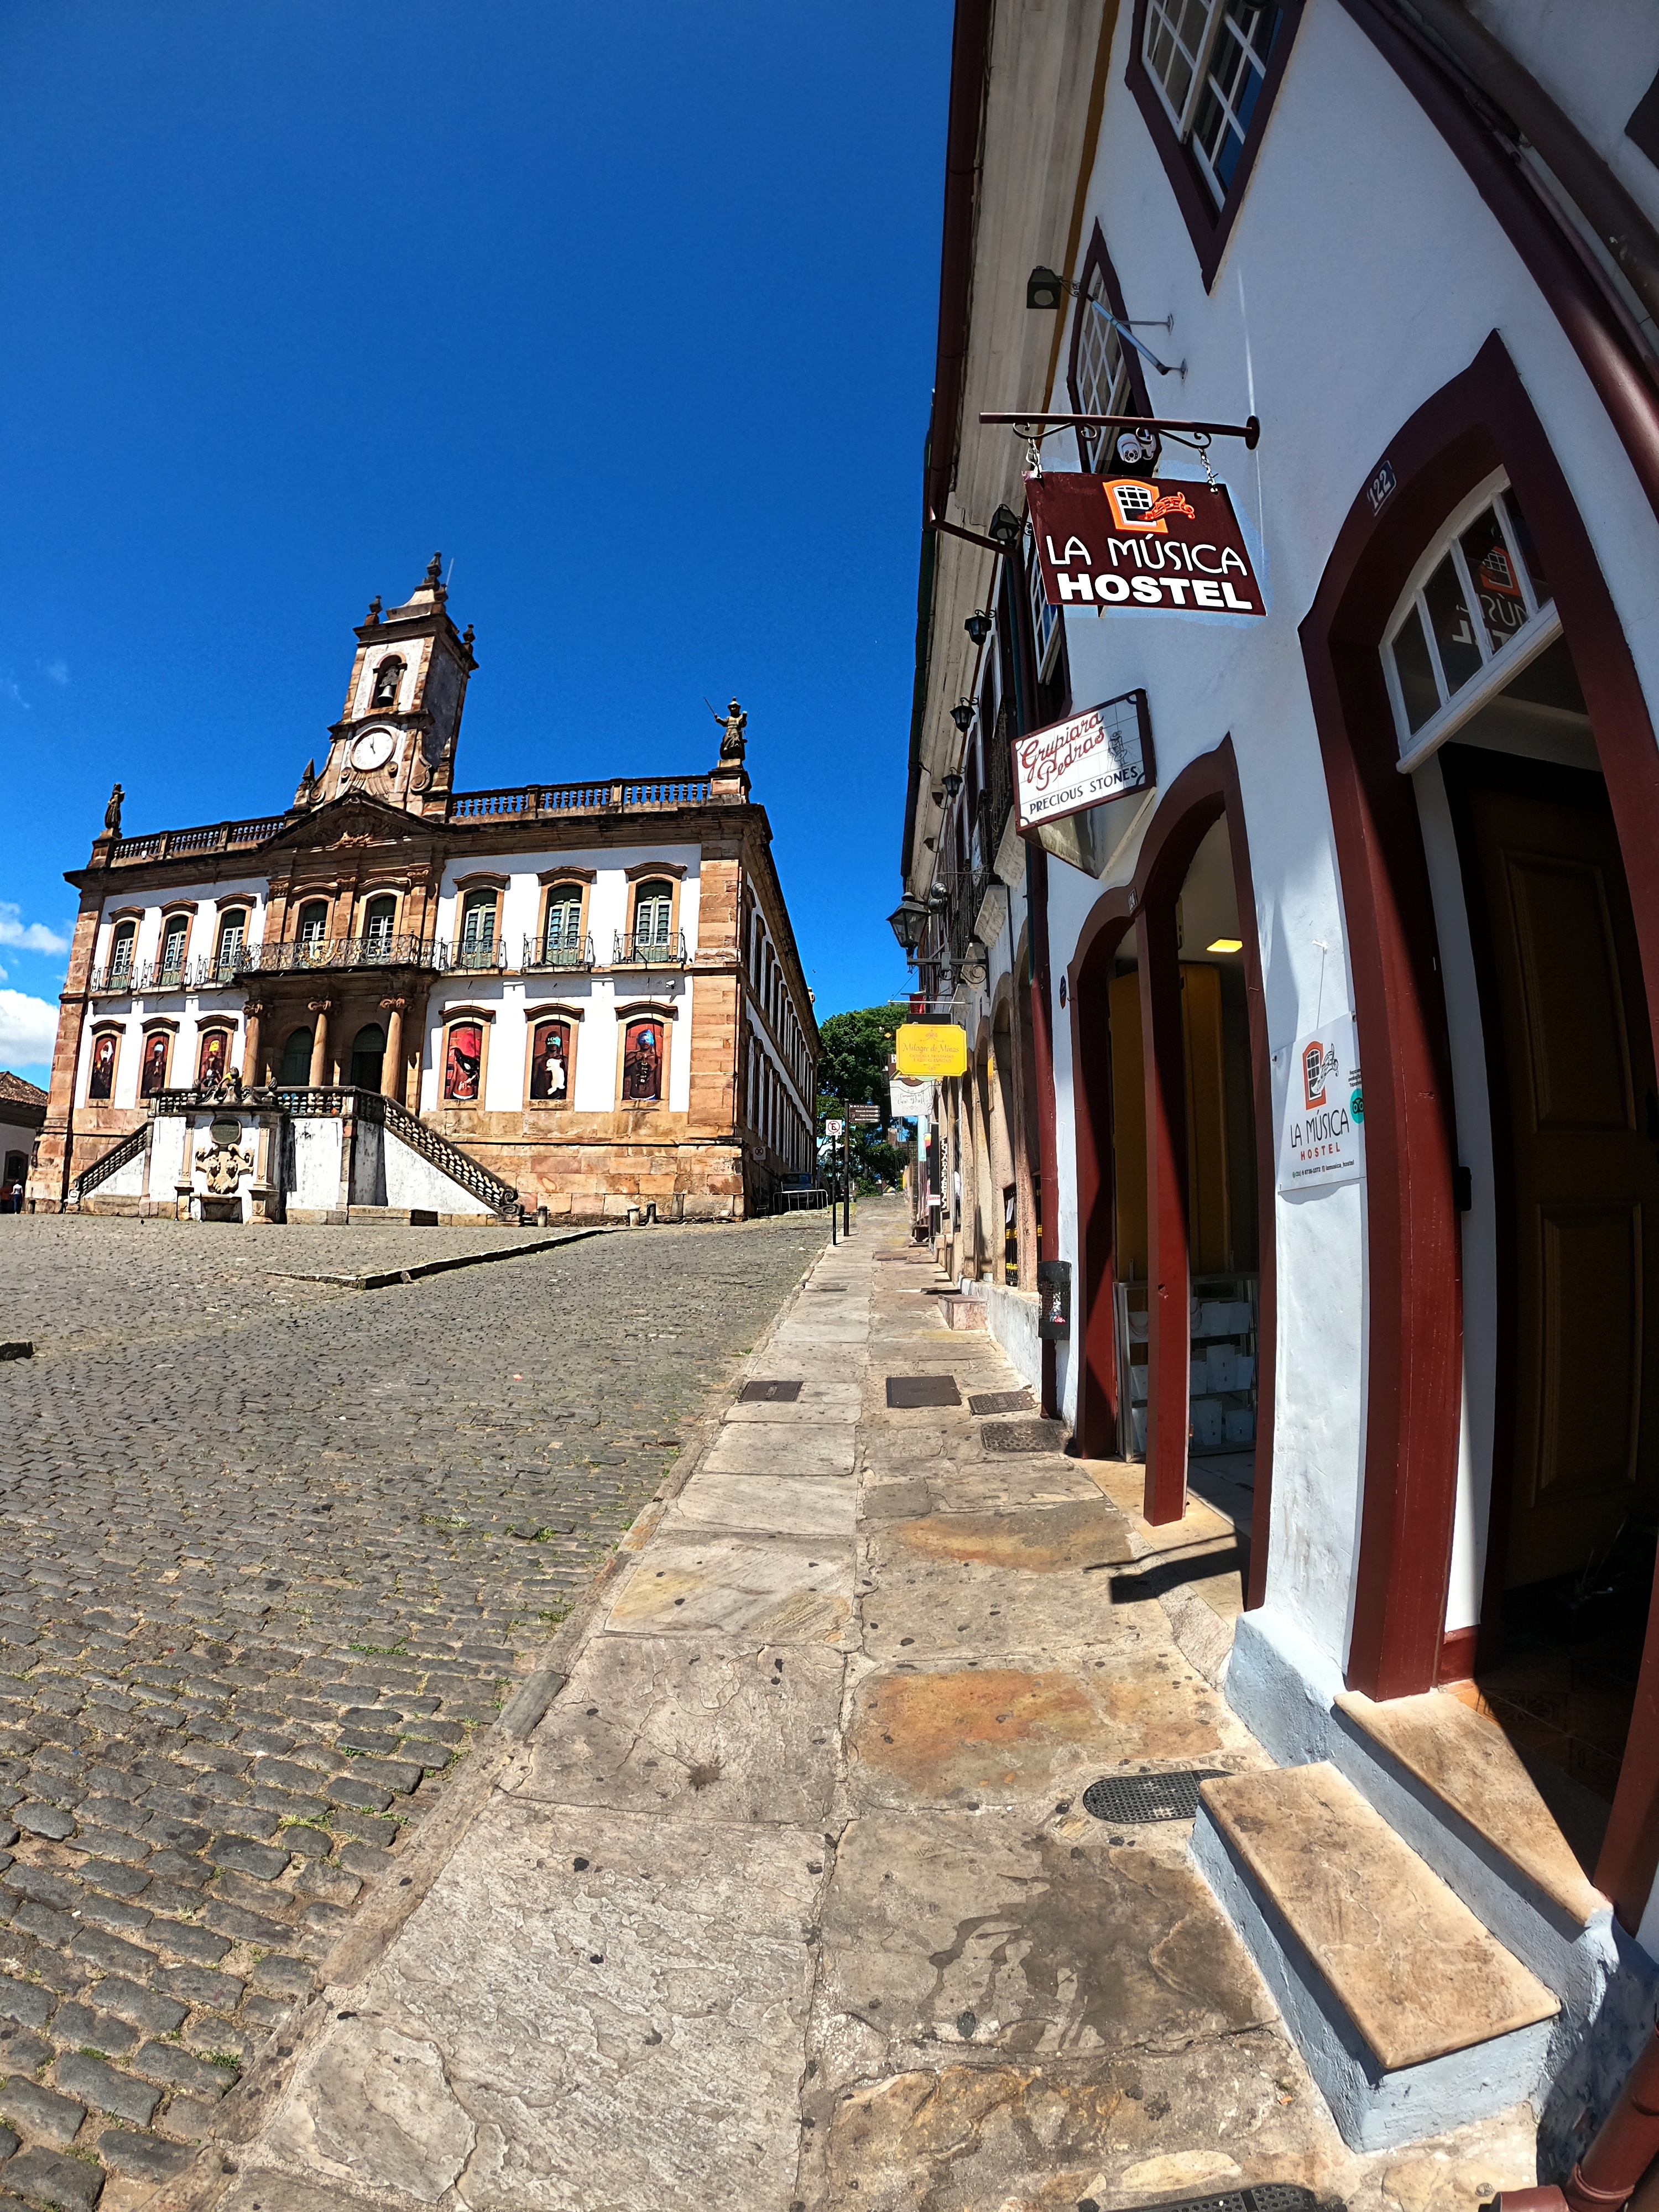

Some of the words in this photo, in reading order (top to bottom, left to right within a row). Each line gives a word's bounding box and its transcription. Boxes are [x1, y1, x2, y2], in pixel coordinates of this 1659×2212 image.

[1369, 469, 1391, 509] 122
[1046, 535, 1091, 566] LA
[1108, 534, 1248, 576] MÚSICA
[1057, 573, 1253, 609] HOSTEL
[1020, 712, 1104, 783] Grupiara
[1036, 726, 1105, 791] Pedras
[1029, 785, 1083, 815] PRECIOUS
[1090, 766, 1138, 792] STONES
[902, 1042, 929, 1053] Milagre
[938, 1044, 959, 1052] Minas
[1290, 1124, 1302, 1148] LA
[1306, 1108, 1349, 1144] MÚSICA
[1301, 1142, 1340, 1161] HOSTEL
